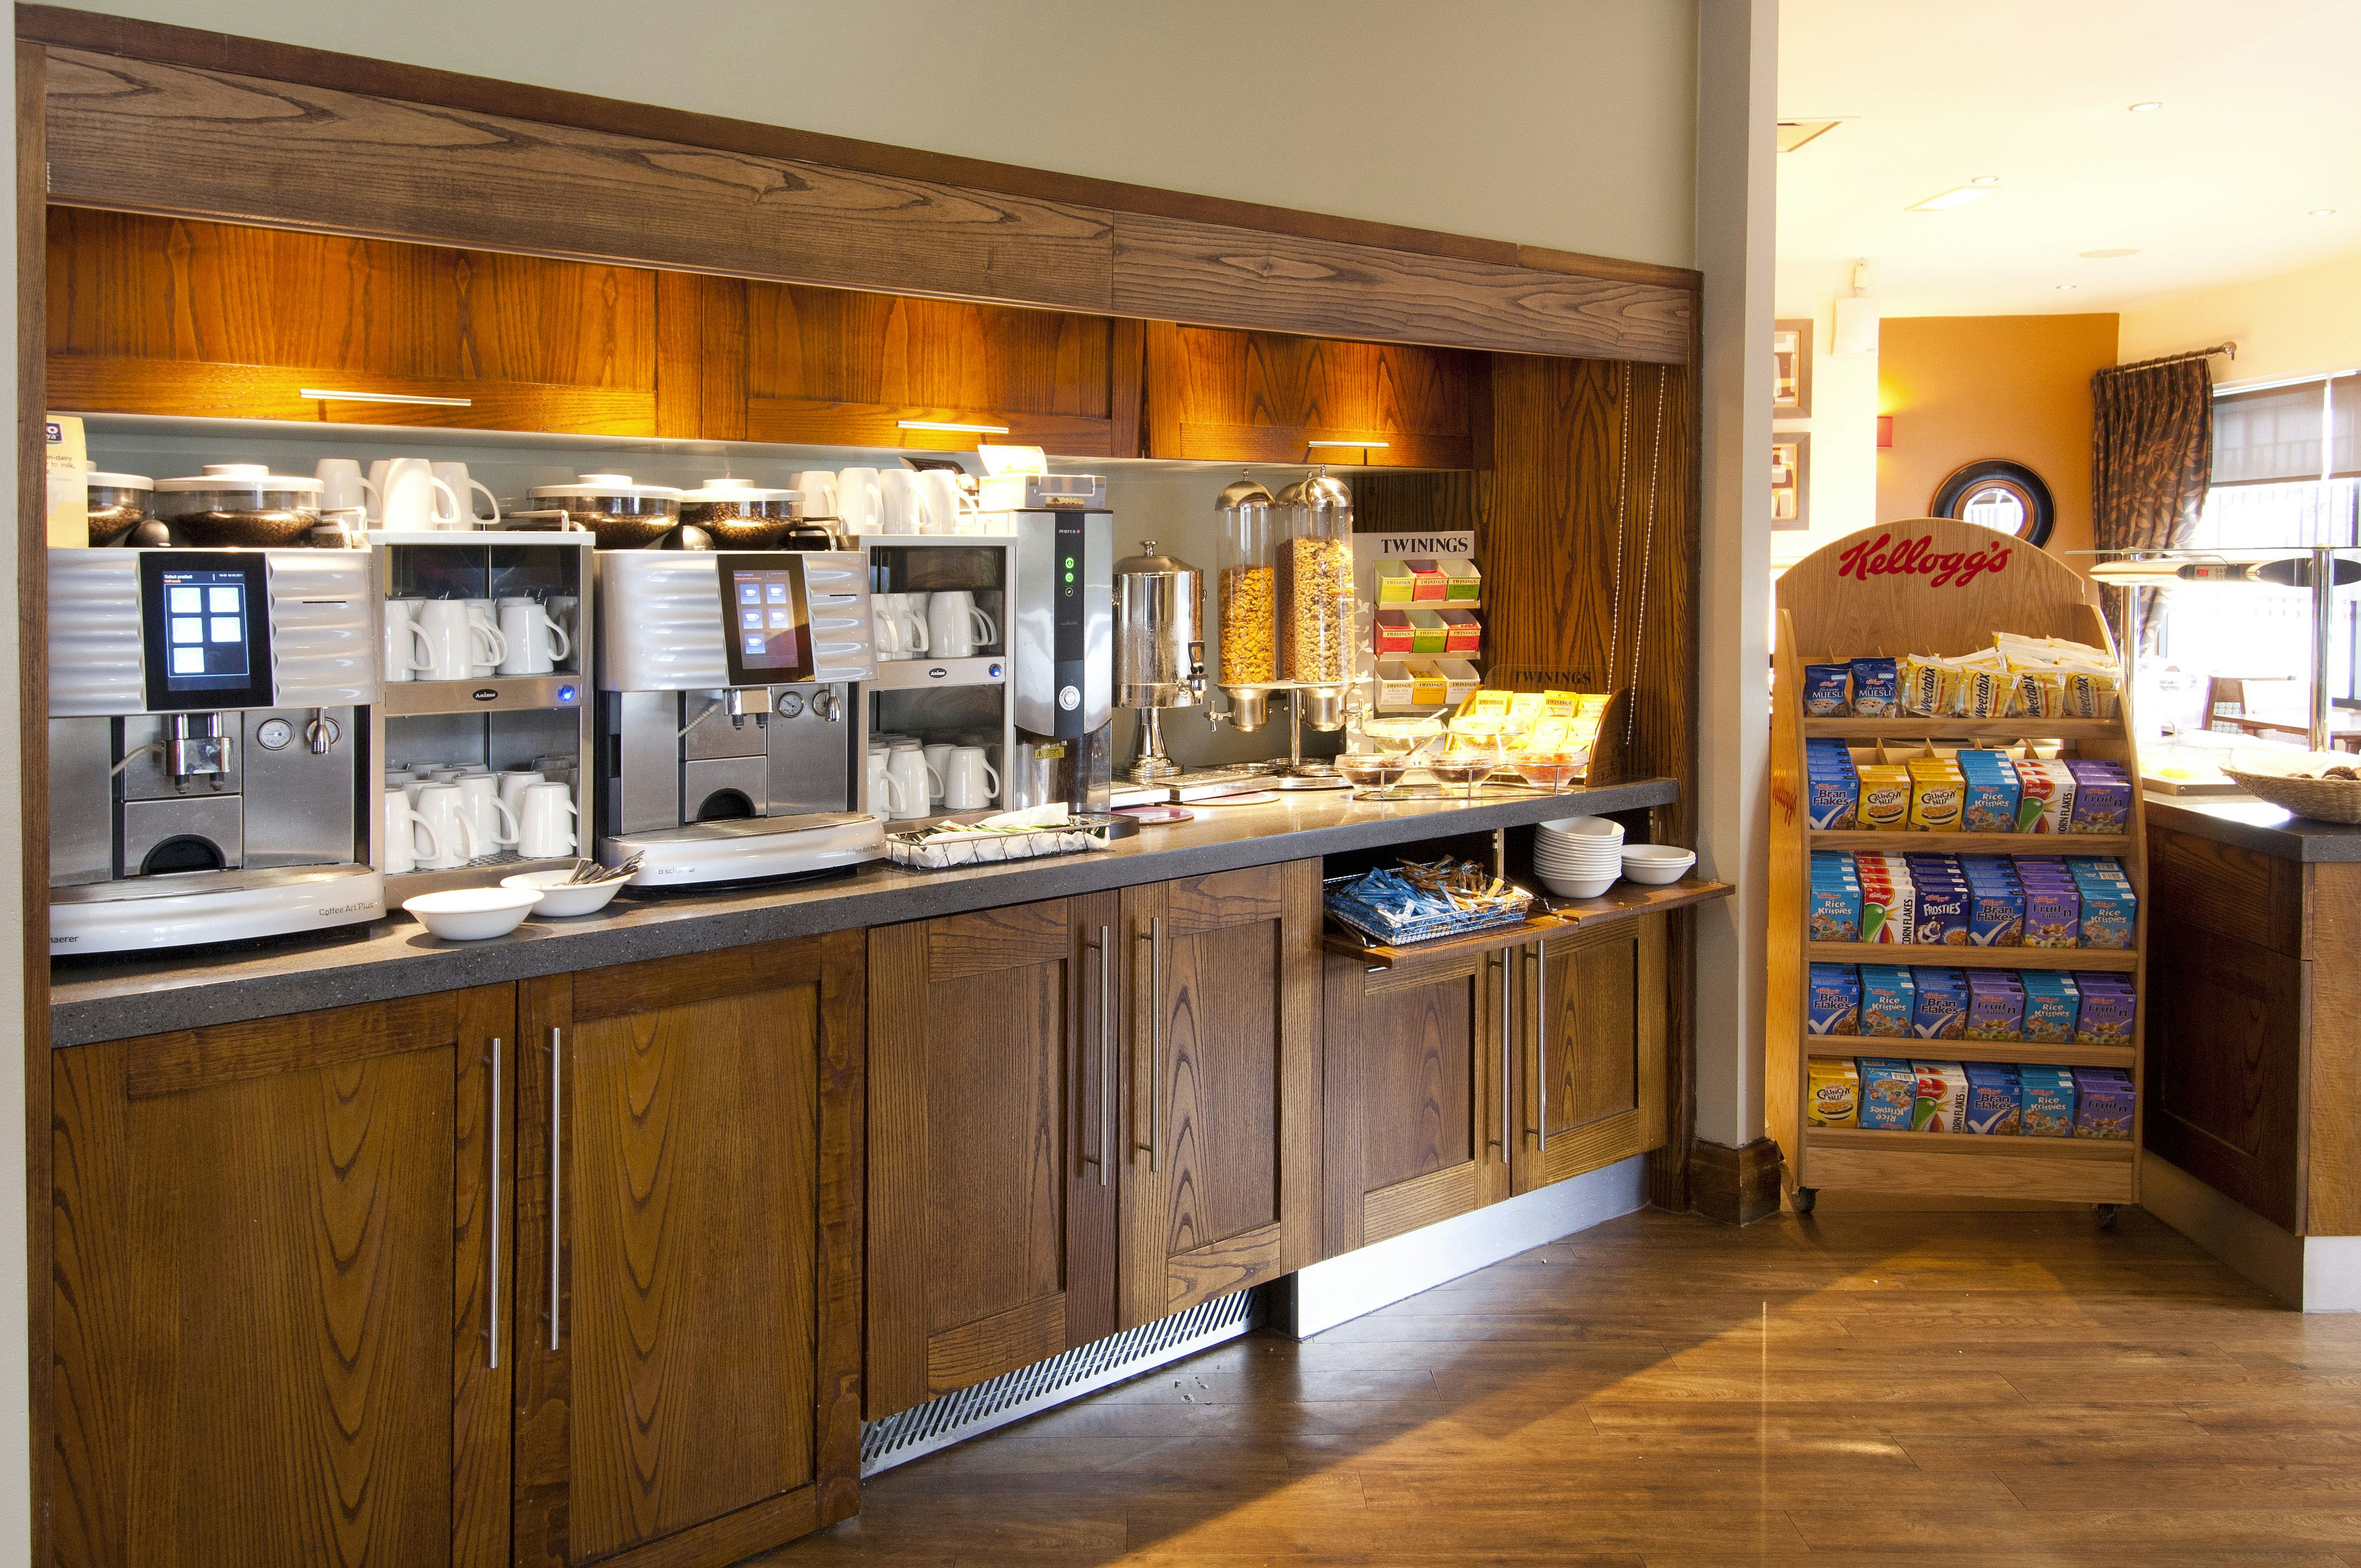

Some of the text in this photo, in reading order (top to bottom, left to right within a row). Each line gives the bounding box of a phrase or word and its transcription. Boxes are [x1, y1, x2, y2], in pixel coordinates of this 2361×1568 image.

[1381, 537, 1468, 553] TWININGS
[1838, 533, 2012, 587] Kellogg's
[1514, 671, 1591, 684] TWININGS
[1920, 666, 1935, 712] Weetabix
[1975, 672, 1990, 718] Weetabix
[2021, 674, 2041, 717] Weetabix
[2076, 675, 2092, 717] Weetabix
[1819, 790, 1847, 798] Bran
[1868, 791, 1902, 803] CRUNCHY
[1921, 791, 1956, 803] CRUNCHY
[2083, 794, 2113, 803] Fruit
[1813, 797, 1849, 806] Flakes
[2061, 793, 2072, 816] FLAKES
[319, 907, 344, 916] Coffee
[1903, 899, 1913, 925] FLAKES
[1923, 902, 1961, 916] FROSTIES
[1983, 905, 2013, 914] Bran
[2033, 903, 2062, 913] Fruit
[1977, 912, 2016, 922] Flakes
[1820, 994, 1848, 1003] Bran
[1927, 999, 1957, 1007] Bran
[1814, 1000, 1852, 1010] Flakes
[1921, 1004, 1960, 1015] Flakes
[2088, 1004, 2118, 1012] Fruit
[1817, 1087, 1851, 1099] CRUNCHY
[1981, 1094, 2010, 1103] Bran
[1954, 1093, 1965, 1116] FLAKES
[1974, 1101, 2014, 1110] Flakes
